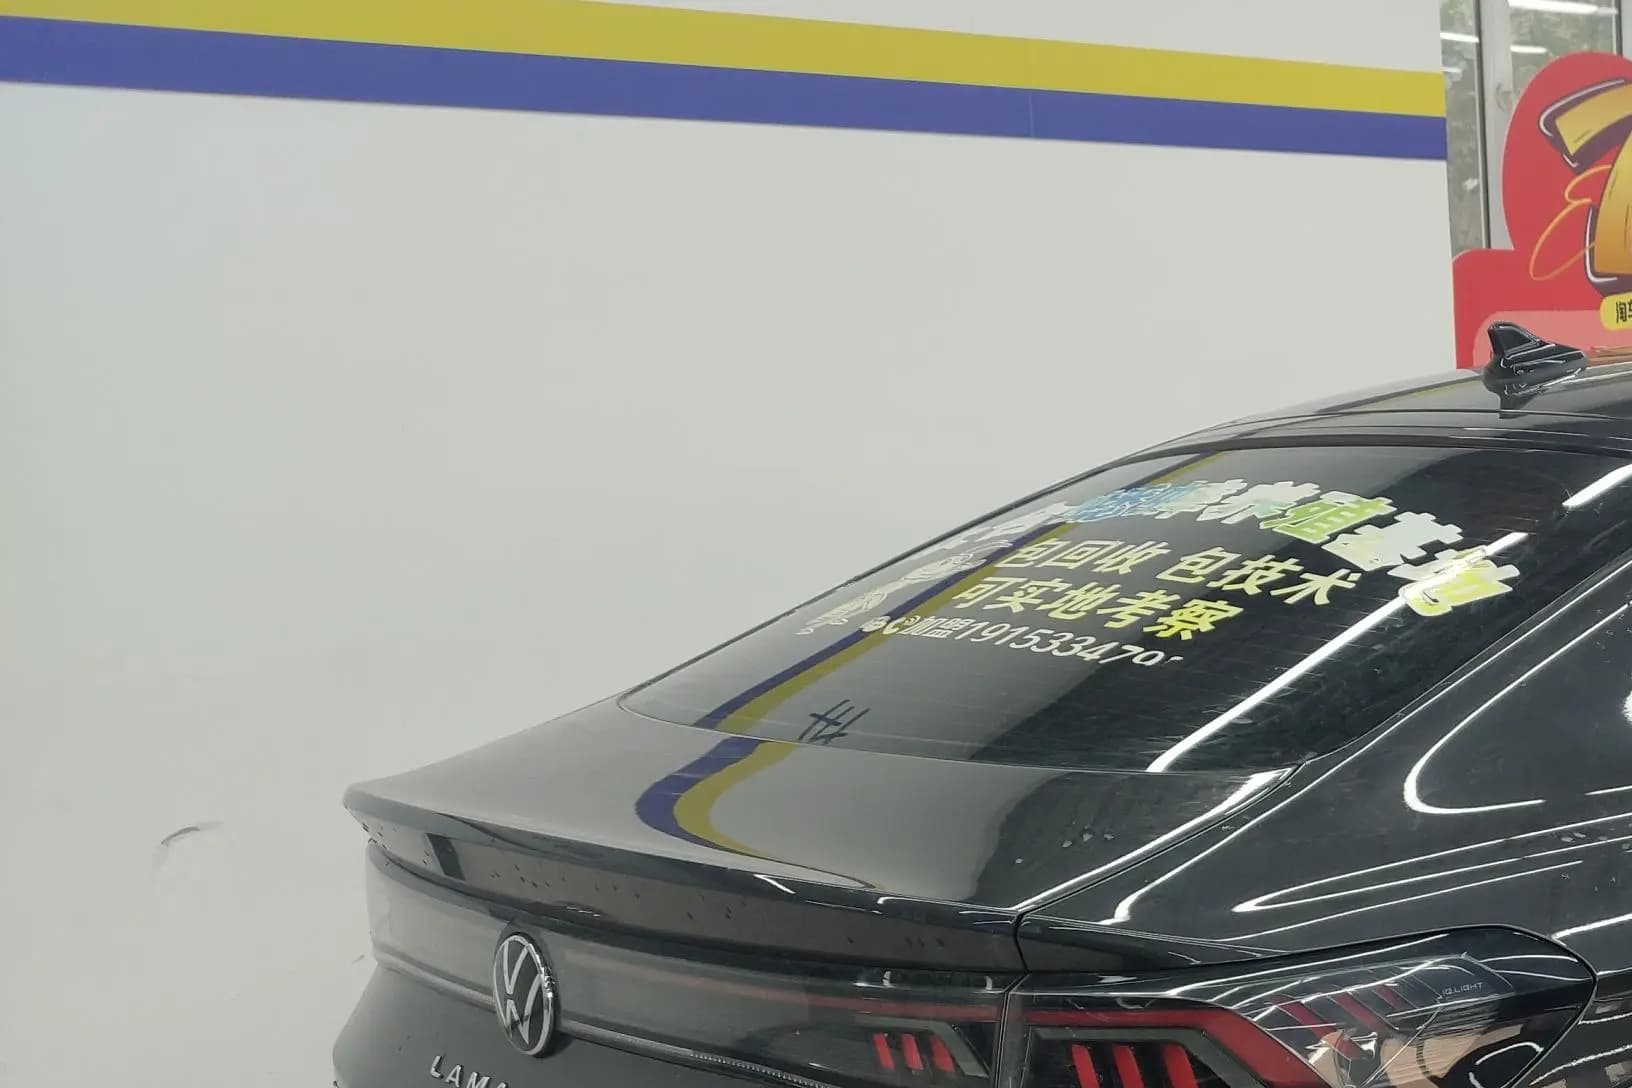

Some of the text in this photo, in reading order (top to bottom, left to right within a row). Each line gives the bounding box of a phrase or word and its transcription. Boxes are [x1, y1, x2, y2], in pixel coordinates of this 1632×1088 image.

[994, 537, 1172, 574] 包回收
[1156, 546, 1362, 606] 包技术
[952, 576, 1244, 640] 可实地考察
